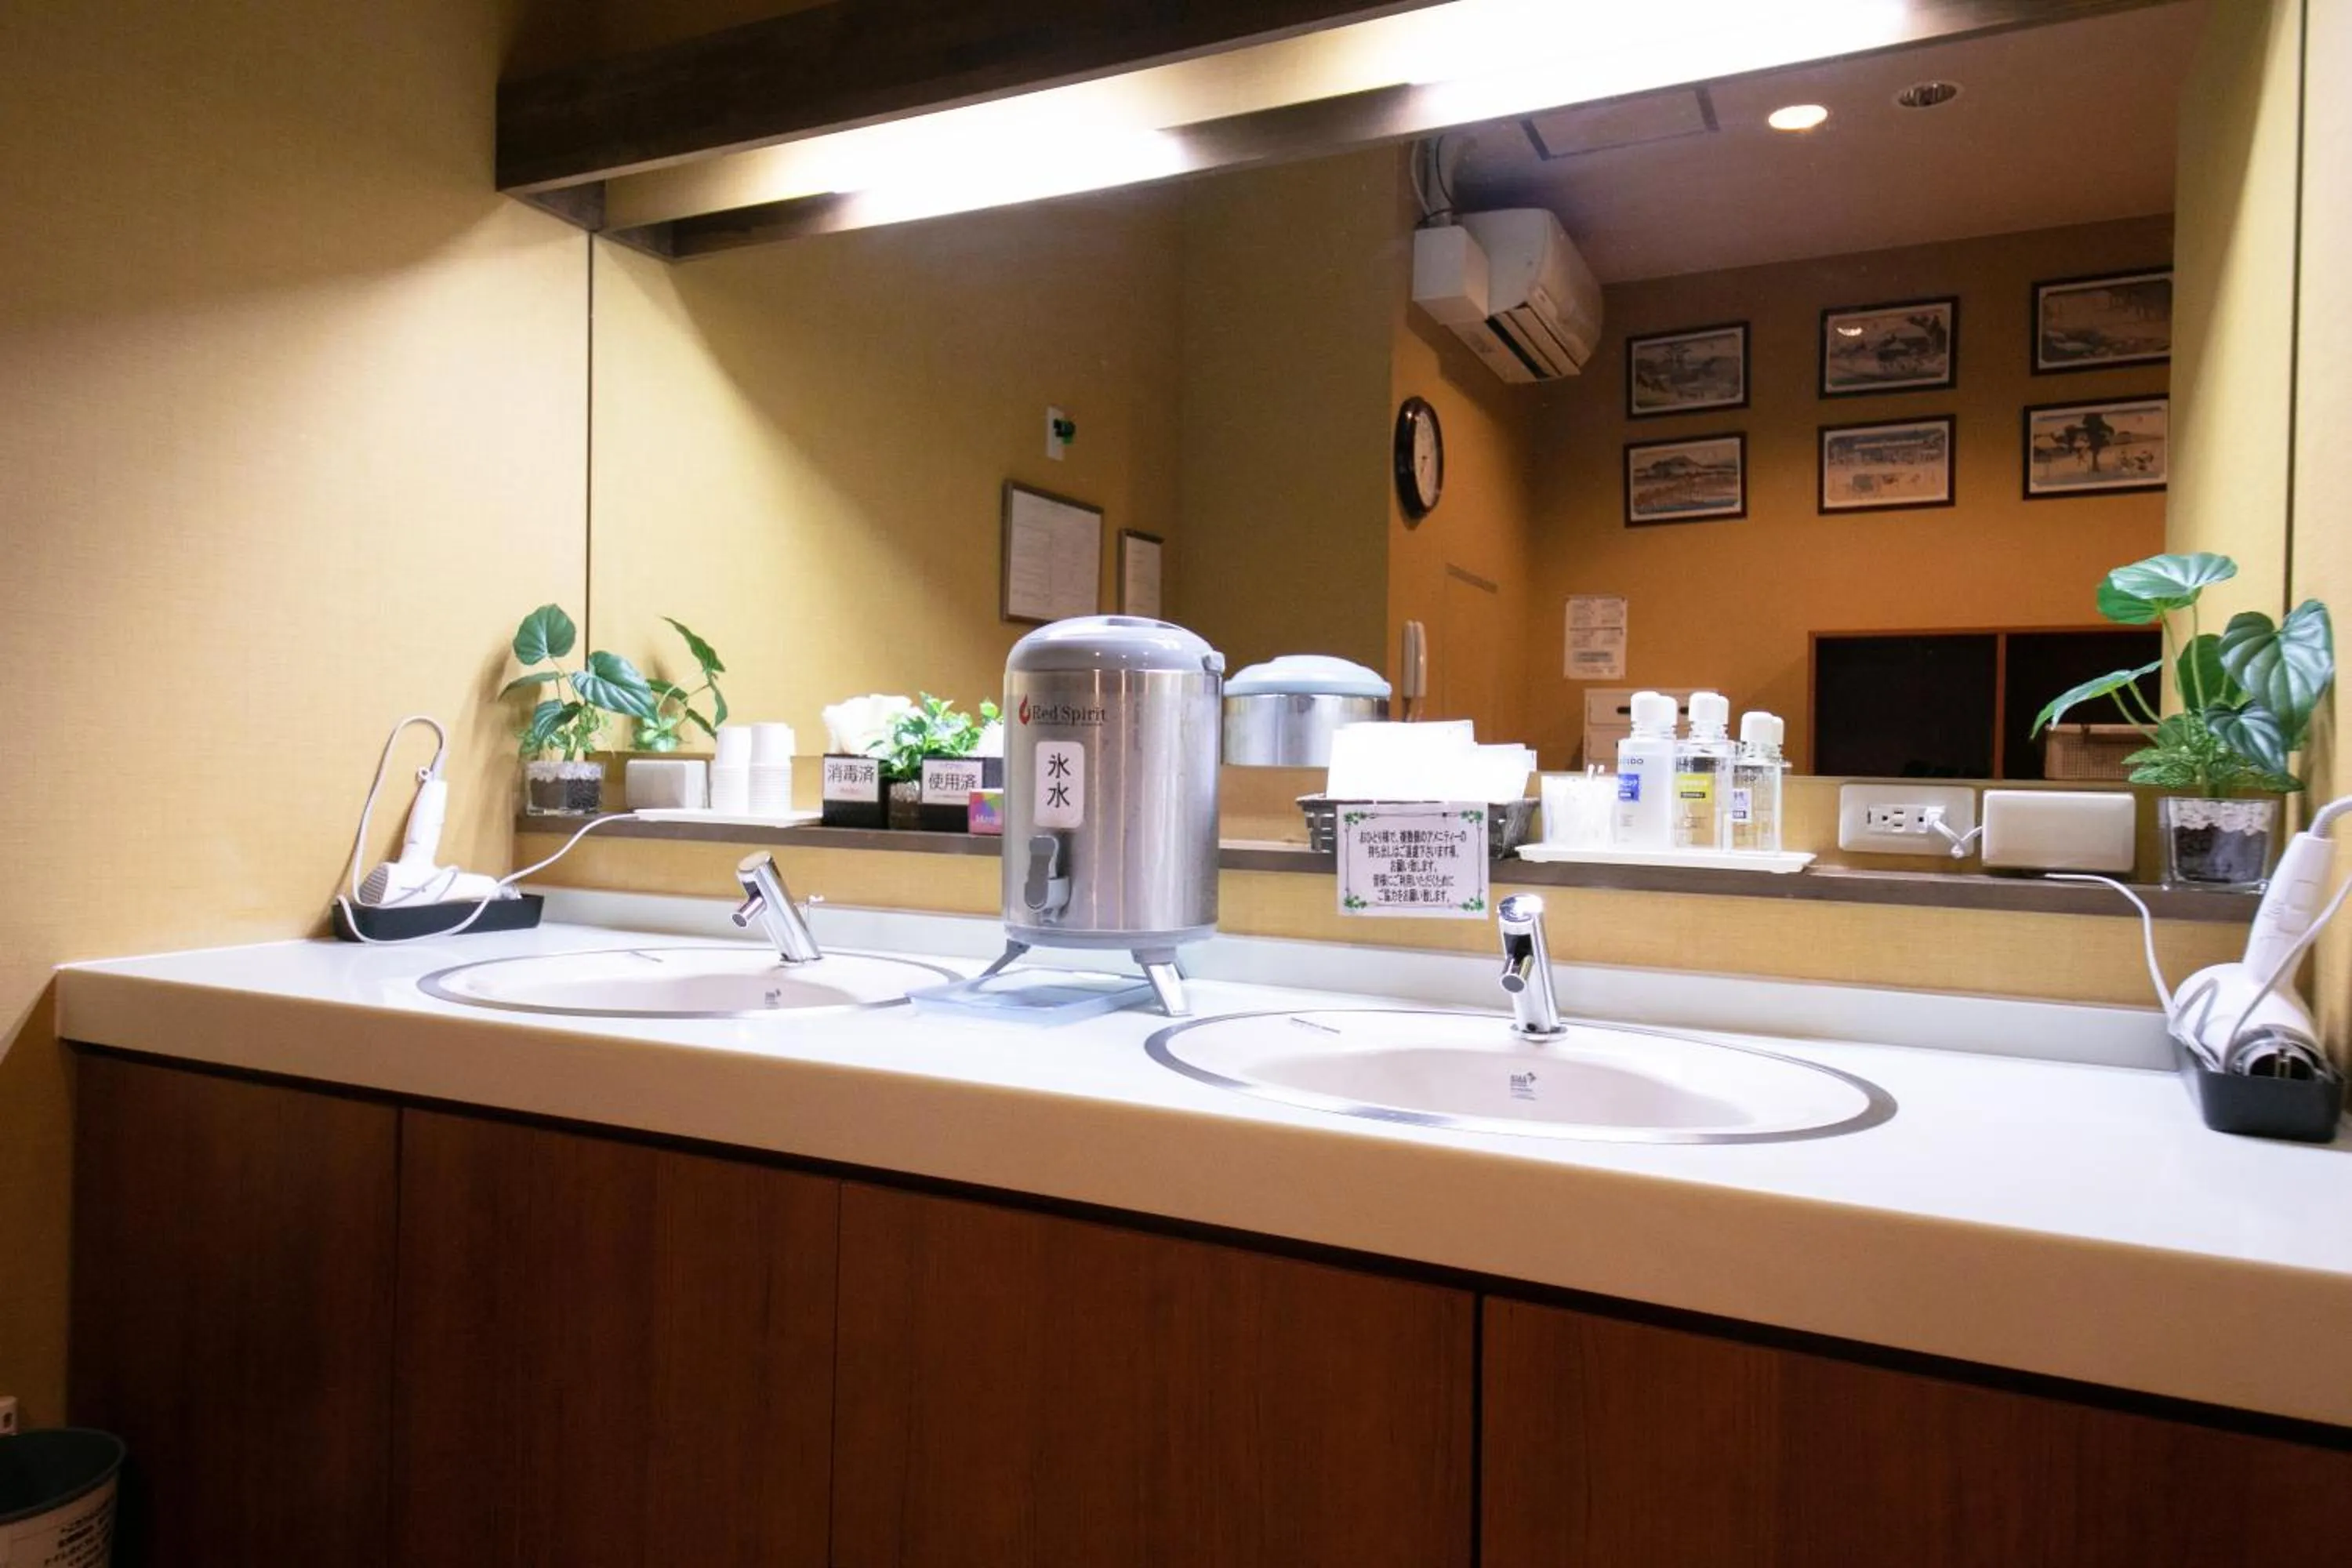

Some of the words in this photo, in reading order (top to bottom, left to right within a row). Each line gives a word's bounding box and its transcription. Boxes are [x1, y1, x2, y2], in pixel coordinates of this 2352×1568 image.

[1033, 705, 1058, 720] Red
[1061, 705, 1106, 725] Spirit
[827, 763, 875, 783] 消毒済
[928, 772, 978, 790] 使用済
[1047, 753, 1071, 808] 氷水
